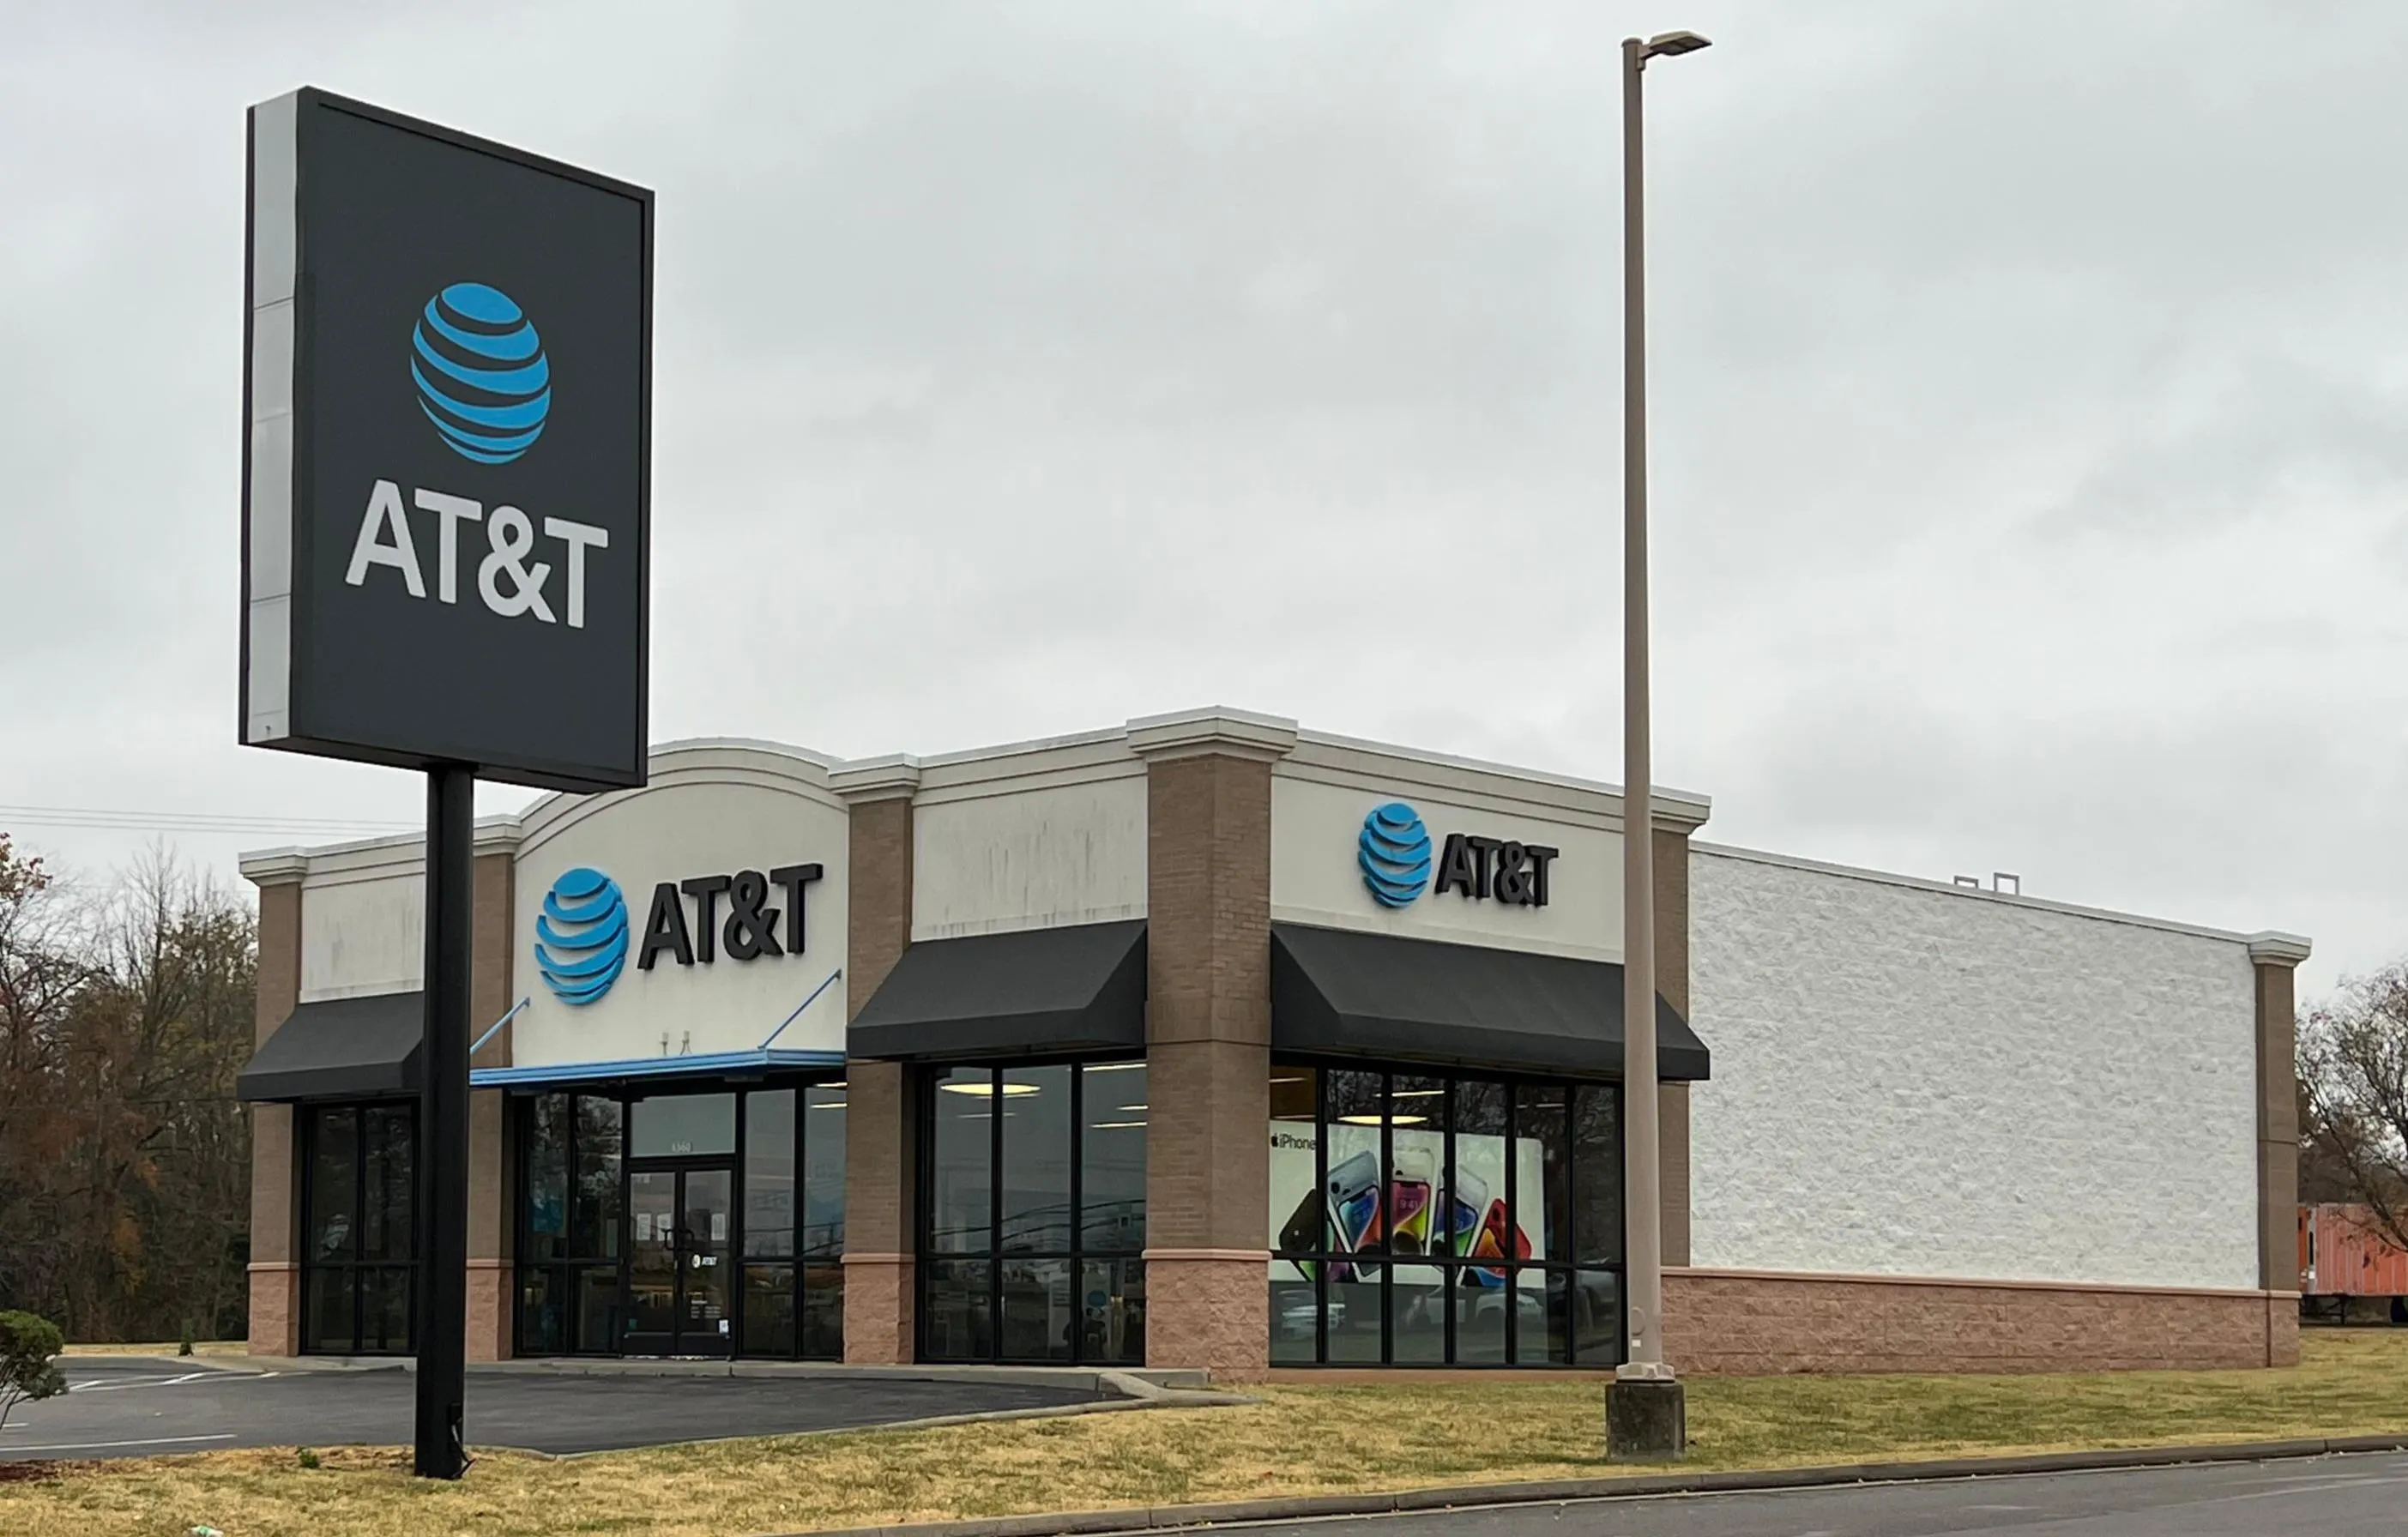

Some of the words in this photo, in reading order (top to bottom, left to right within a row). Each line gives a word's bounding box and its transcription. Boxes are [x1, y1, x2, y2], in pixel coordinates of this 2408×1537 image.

[345, 479, 609, 628] AT&T
[1434, 833, 1559, 907] AT&T
[637, 862, 824, 970] AT&T
[1279, 1133, 1316, 1150] iPhone
